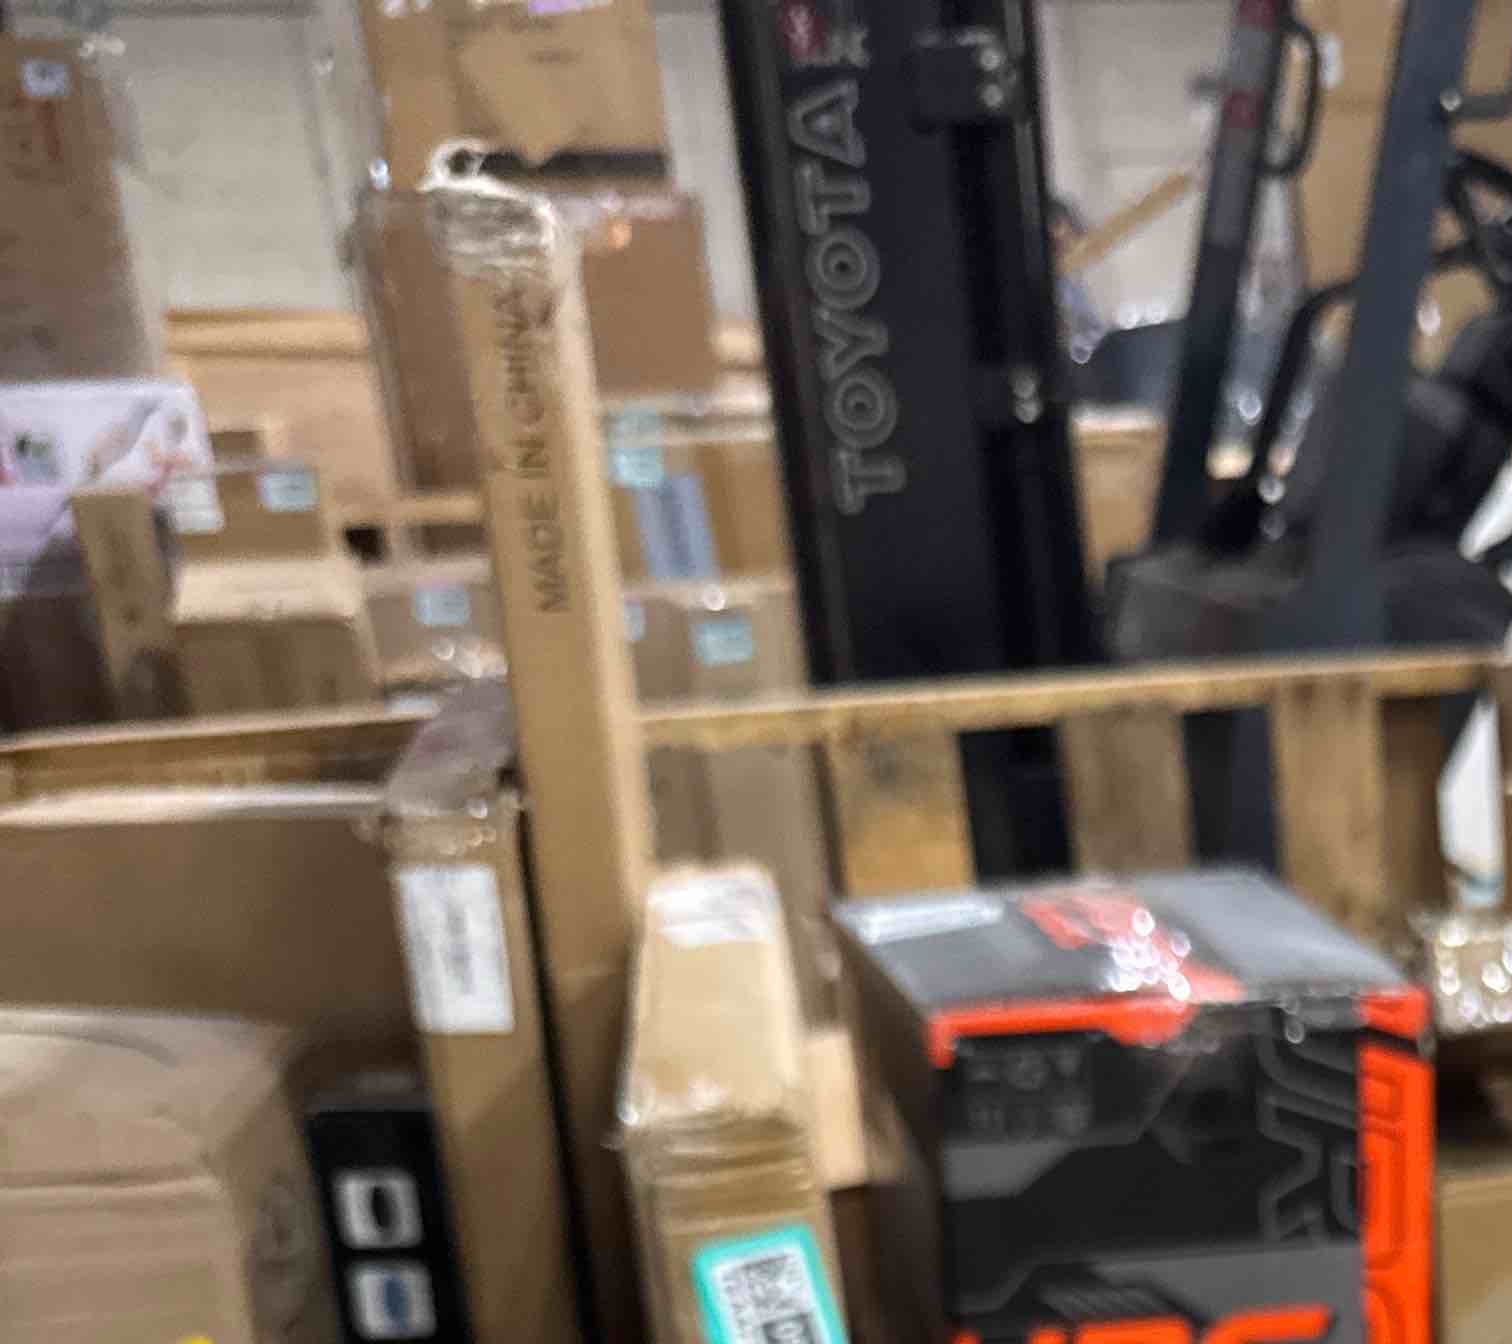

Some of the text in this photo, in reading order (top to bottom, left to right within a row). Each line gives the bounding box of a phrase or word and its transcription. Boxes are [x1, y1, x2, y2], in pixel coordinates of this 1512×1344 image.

[492, 283, 572, 615] MADE IN CHINA
[787, 79, 908, 516] TOYOTA
